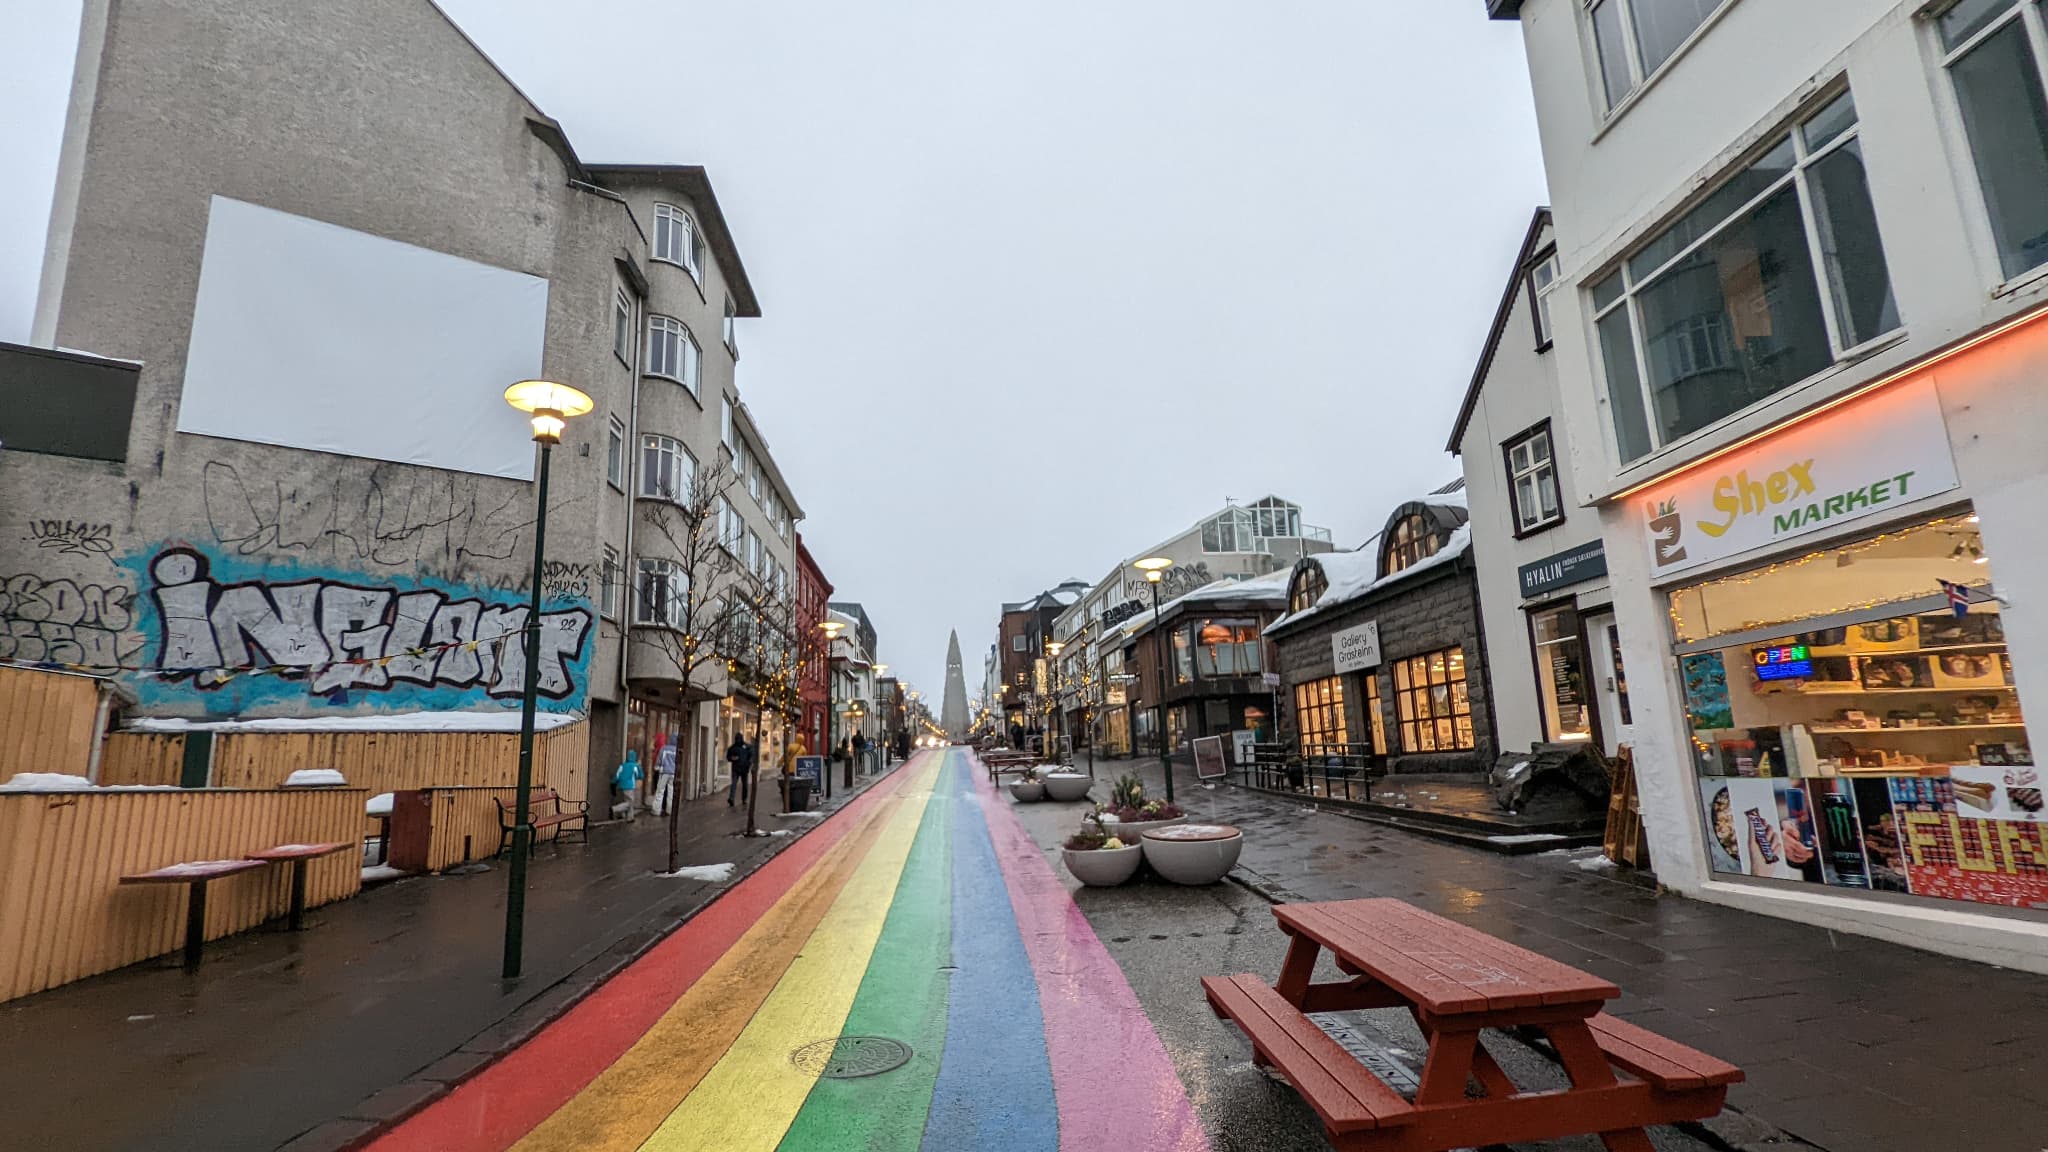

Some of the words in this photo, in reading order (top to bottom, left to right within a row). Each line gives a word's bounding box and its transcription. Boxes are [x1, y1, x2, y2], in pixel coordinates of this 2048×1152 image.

[1697, 459, 1816, 538] Shex
[1773, 471, 1915, 535] MARKET
[1526, 561, 1563, 588] HYALIN
[1755, 645, 1807, 665] OPEN
